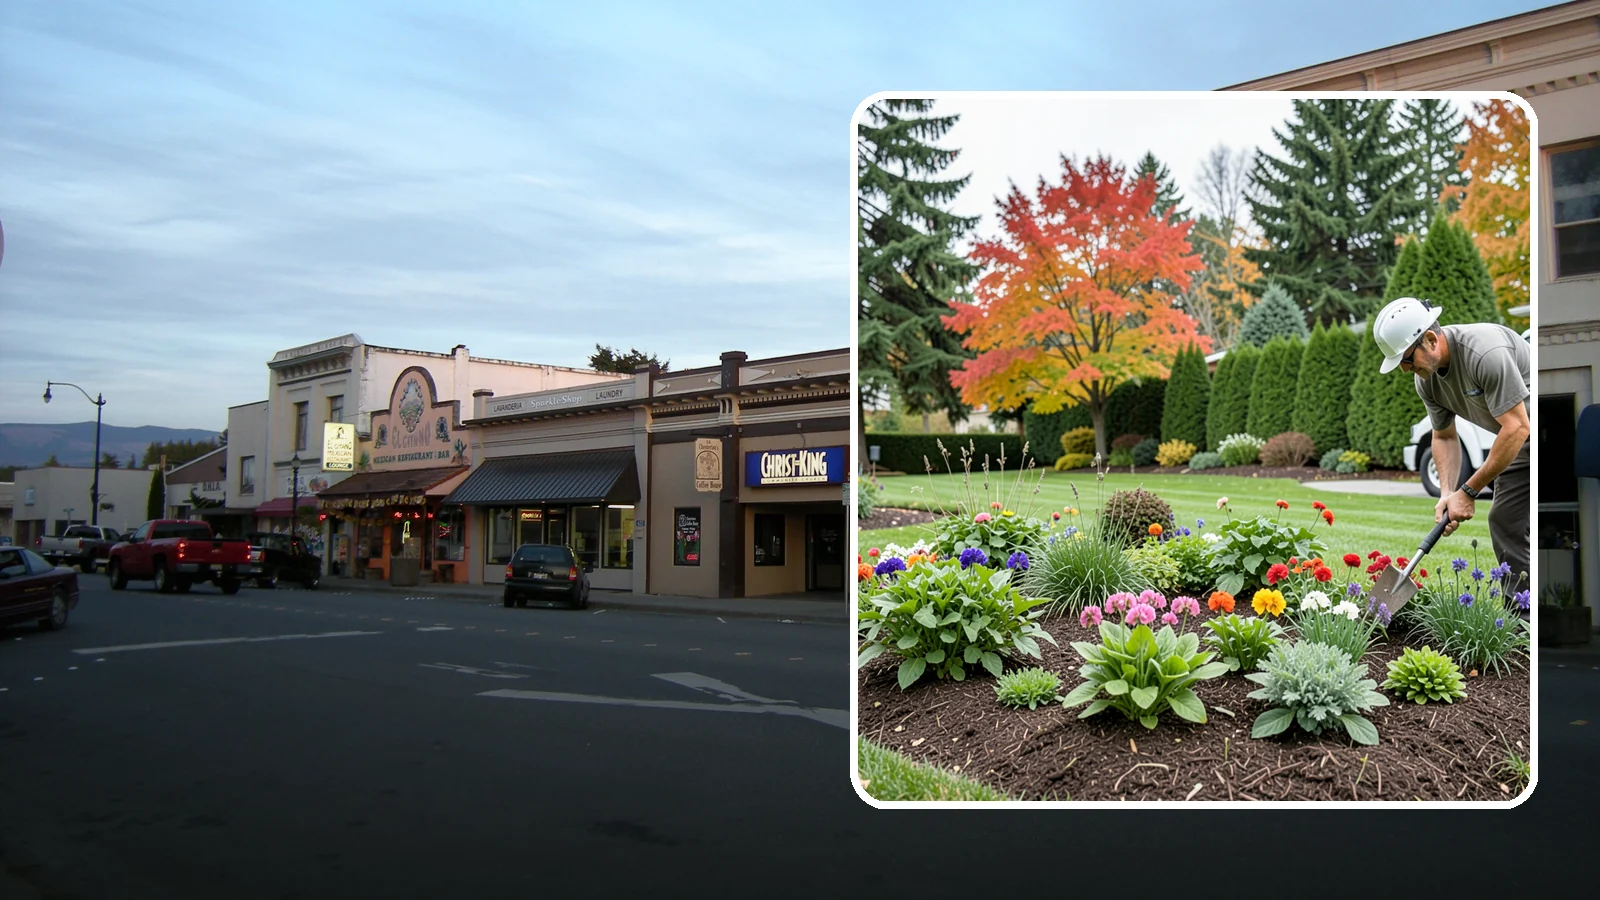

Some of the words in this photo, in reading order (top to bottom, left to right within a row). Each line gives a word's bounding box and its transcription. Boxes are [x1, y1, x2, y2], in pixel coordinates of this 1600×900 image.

[493, 402, 523, 413] LAVANDERIA
[531, 397, 560, 409] Sparkle
[561, 395, 583, 405] Shop
[595, 389, 624, 400] LAUNDRY
[374, 455, 396, 464] MEXICAN
[397, 451, 434, 462] RESTAURANT
[438, 450, 450, 459] BAR
[760, 452, 797, 478] CHRIST
[799, 450, 828, 476] KING
